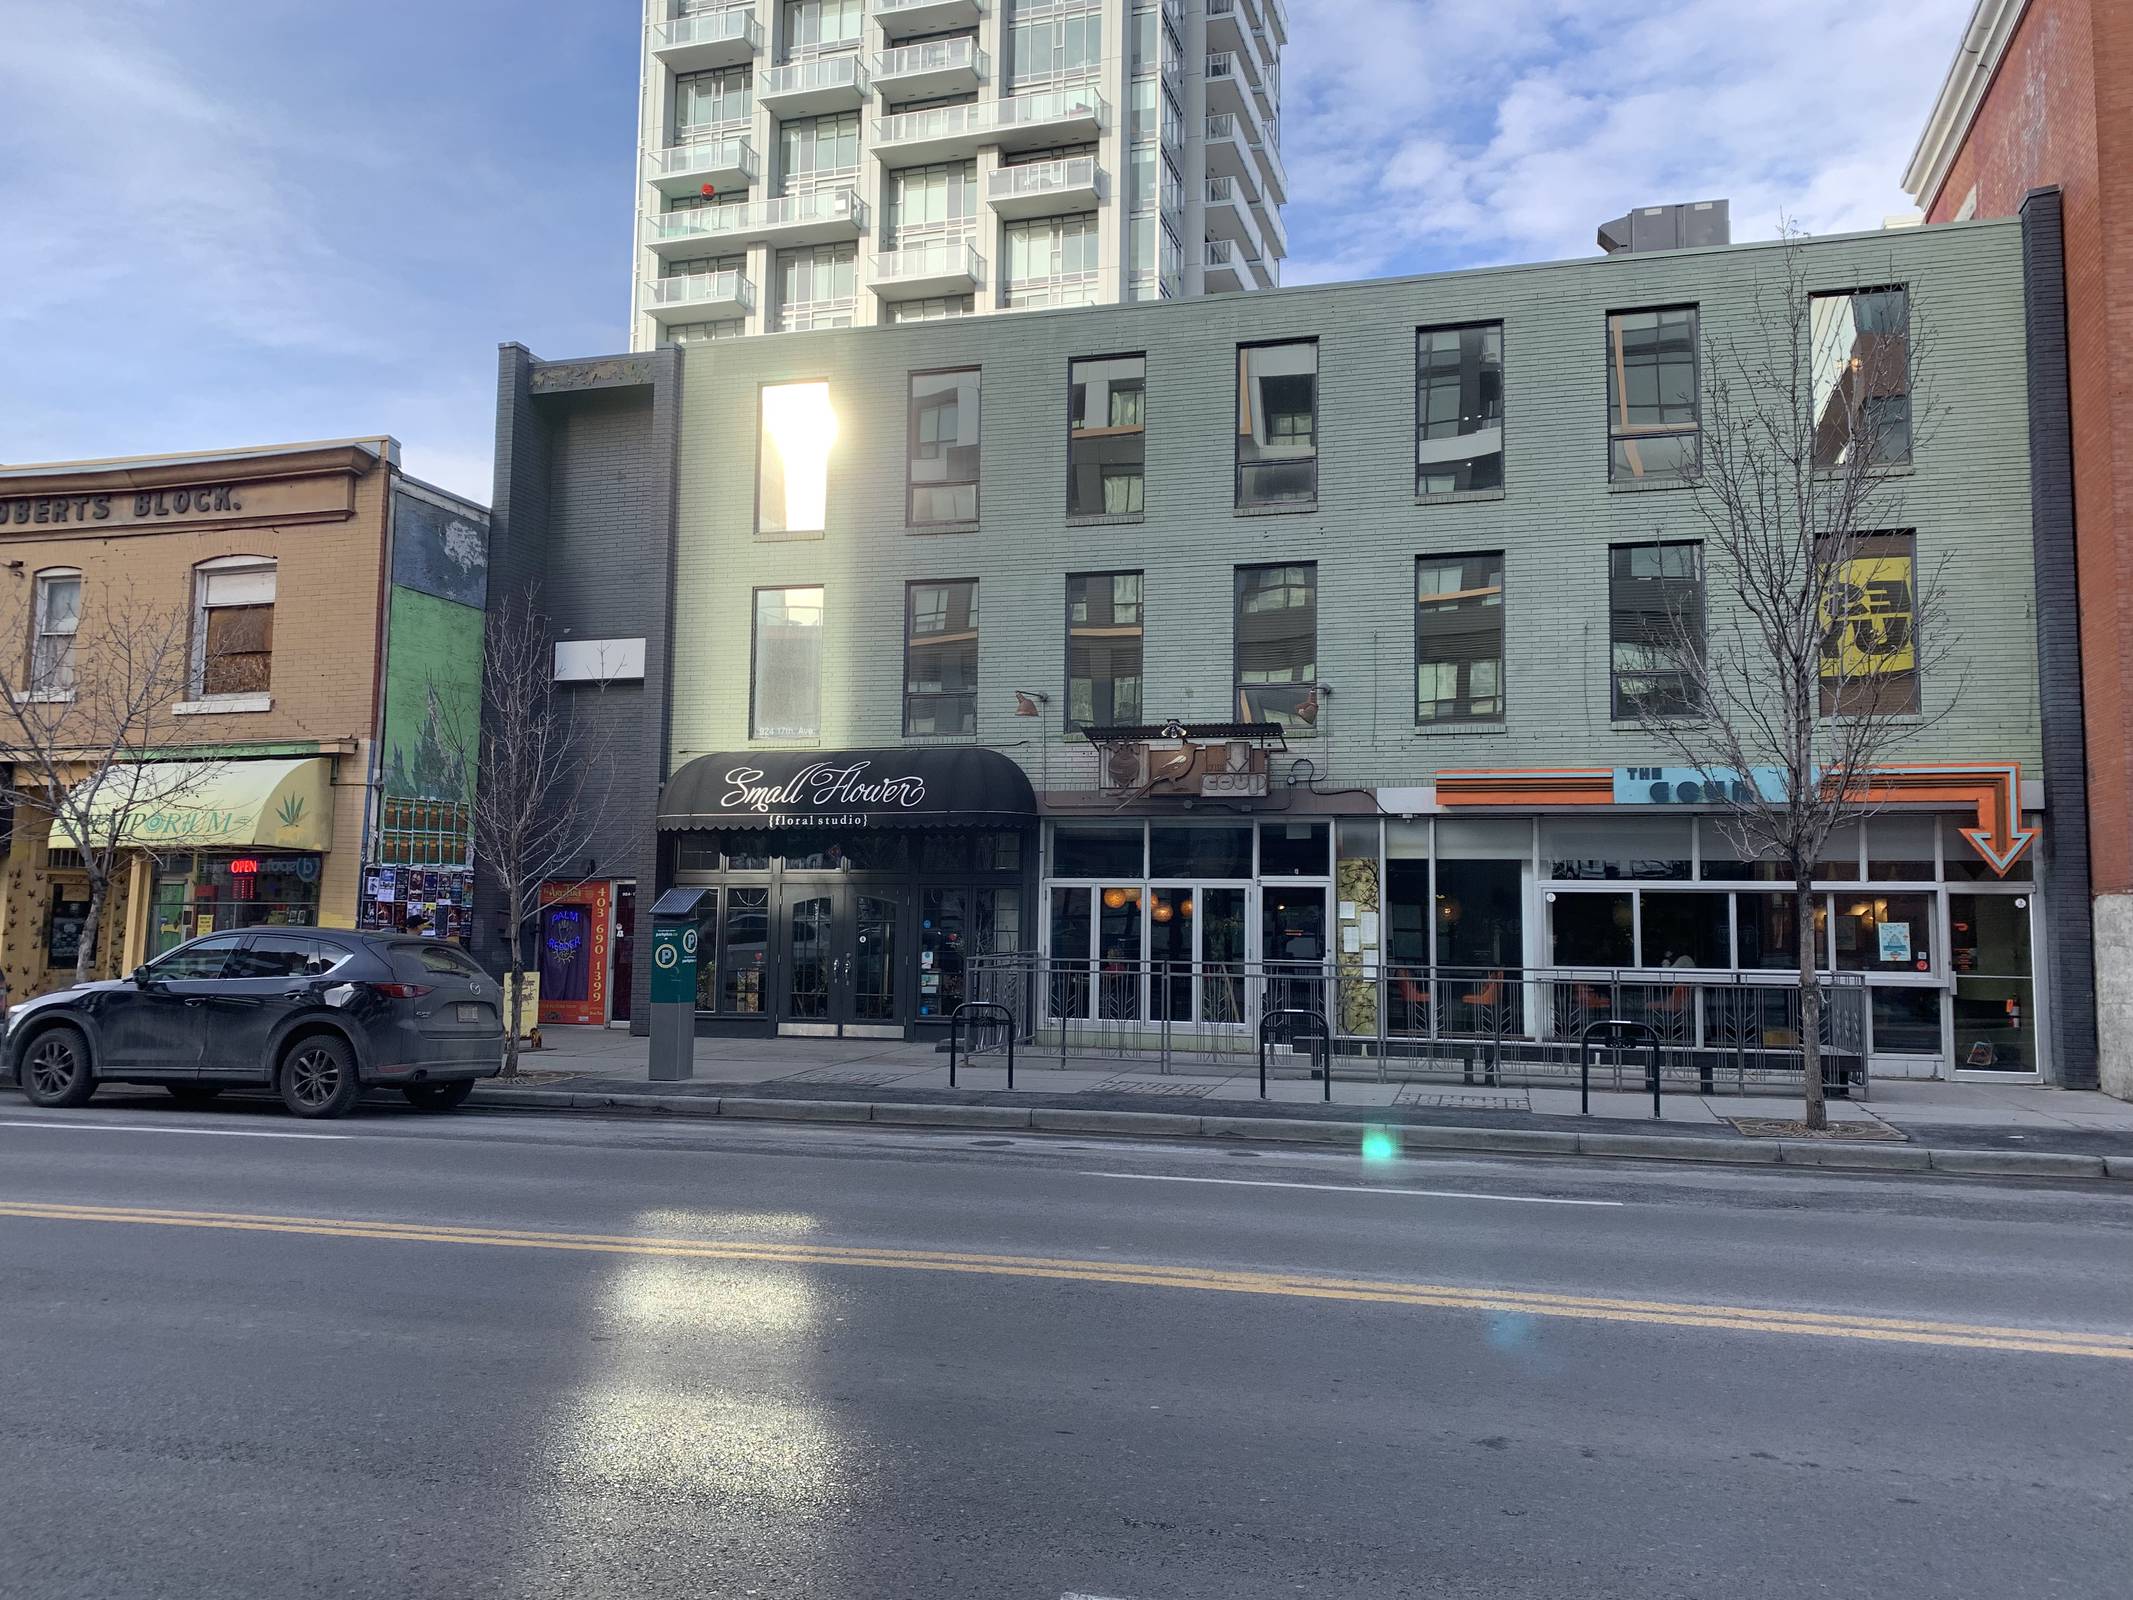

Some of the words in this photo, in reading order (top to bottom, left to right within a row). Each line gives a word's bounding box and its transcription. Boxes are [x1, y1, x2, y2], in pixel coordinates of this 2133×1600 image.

[721, 762, 833, 812] Small
[810, 761, 926, 807] Flower
[1627, 768, 1662, 780] THE
[231, 860, 257, 873] OPEN
[552, 911, 579, 924] PALM
[597, 887, 607, 918] 403
[595, 924, 605, 955] 690
[593, 961, 602, 1002] 1399
